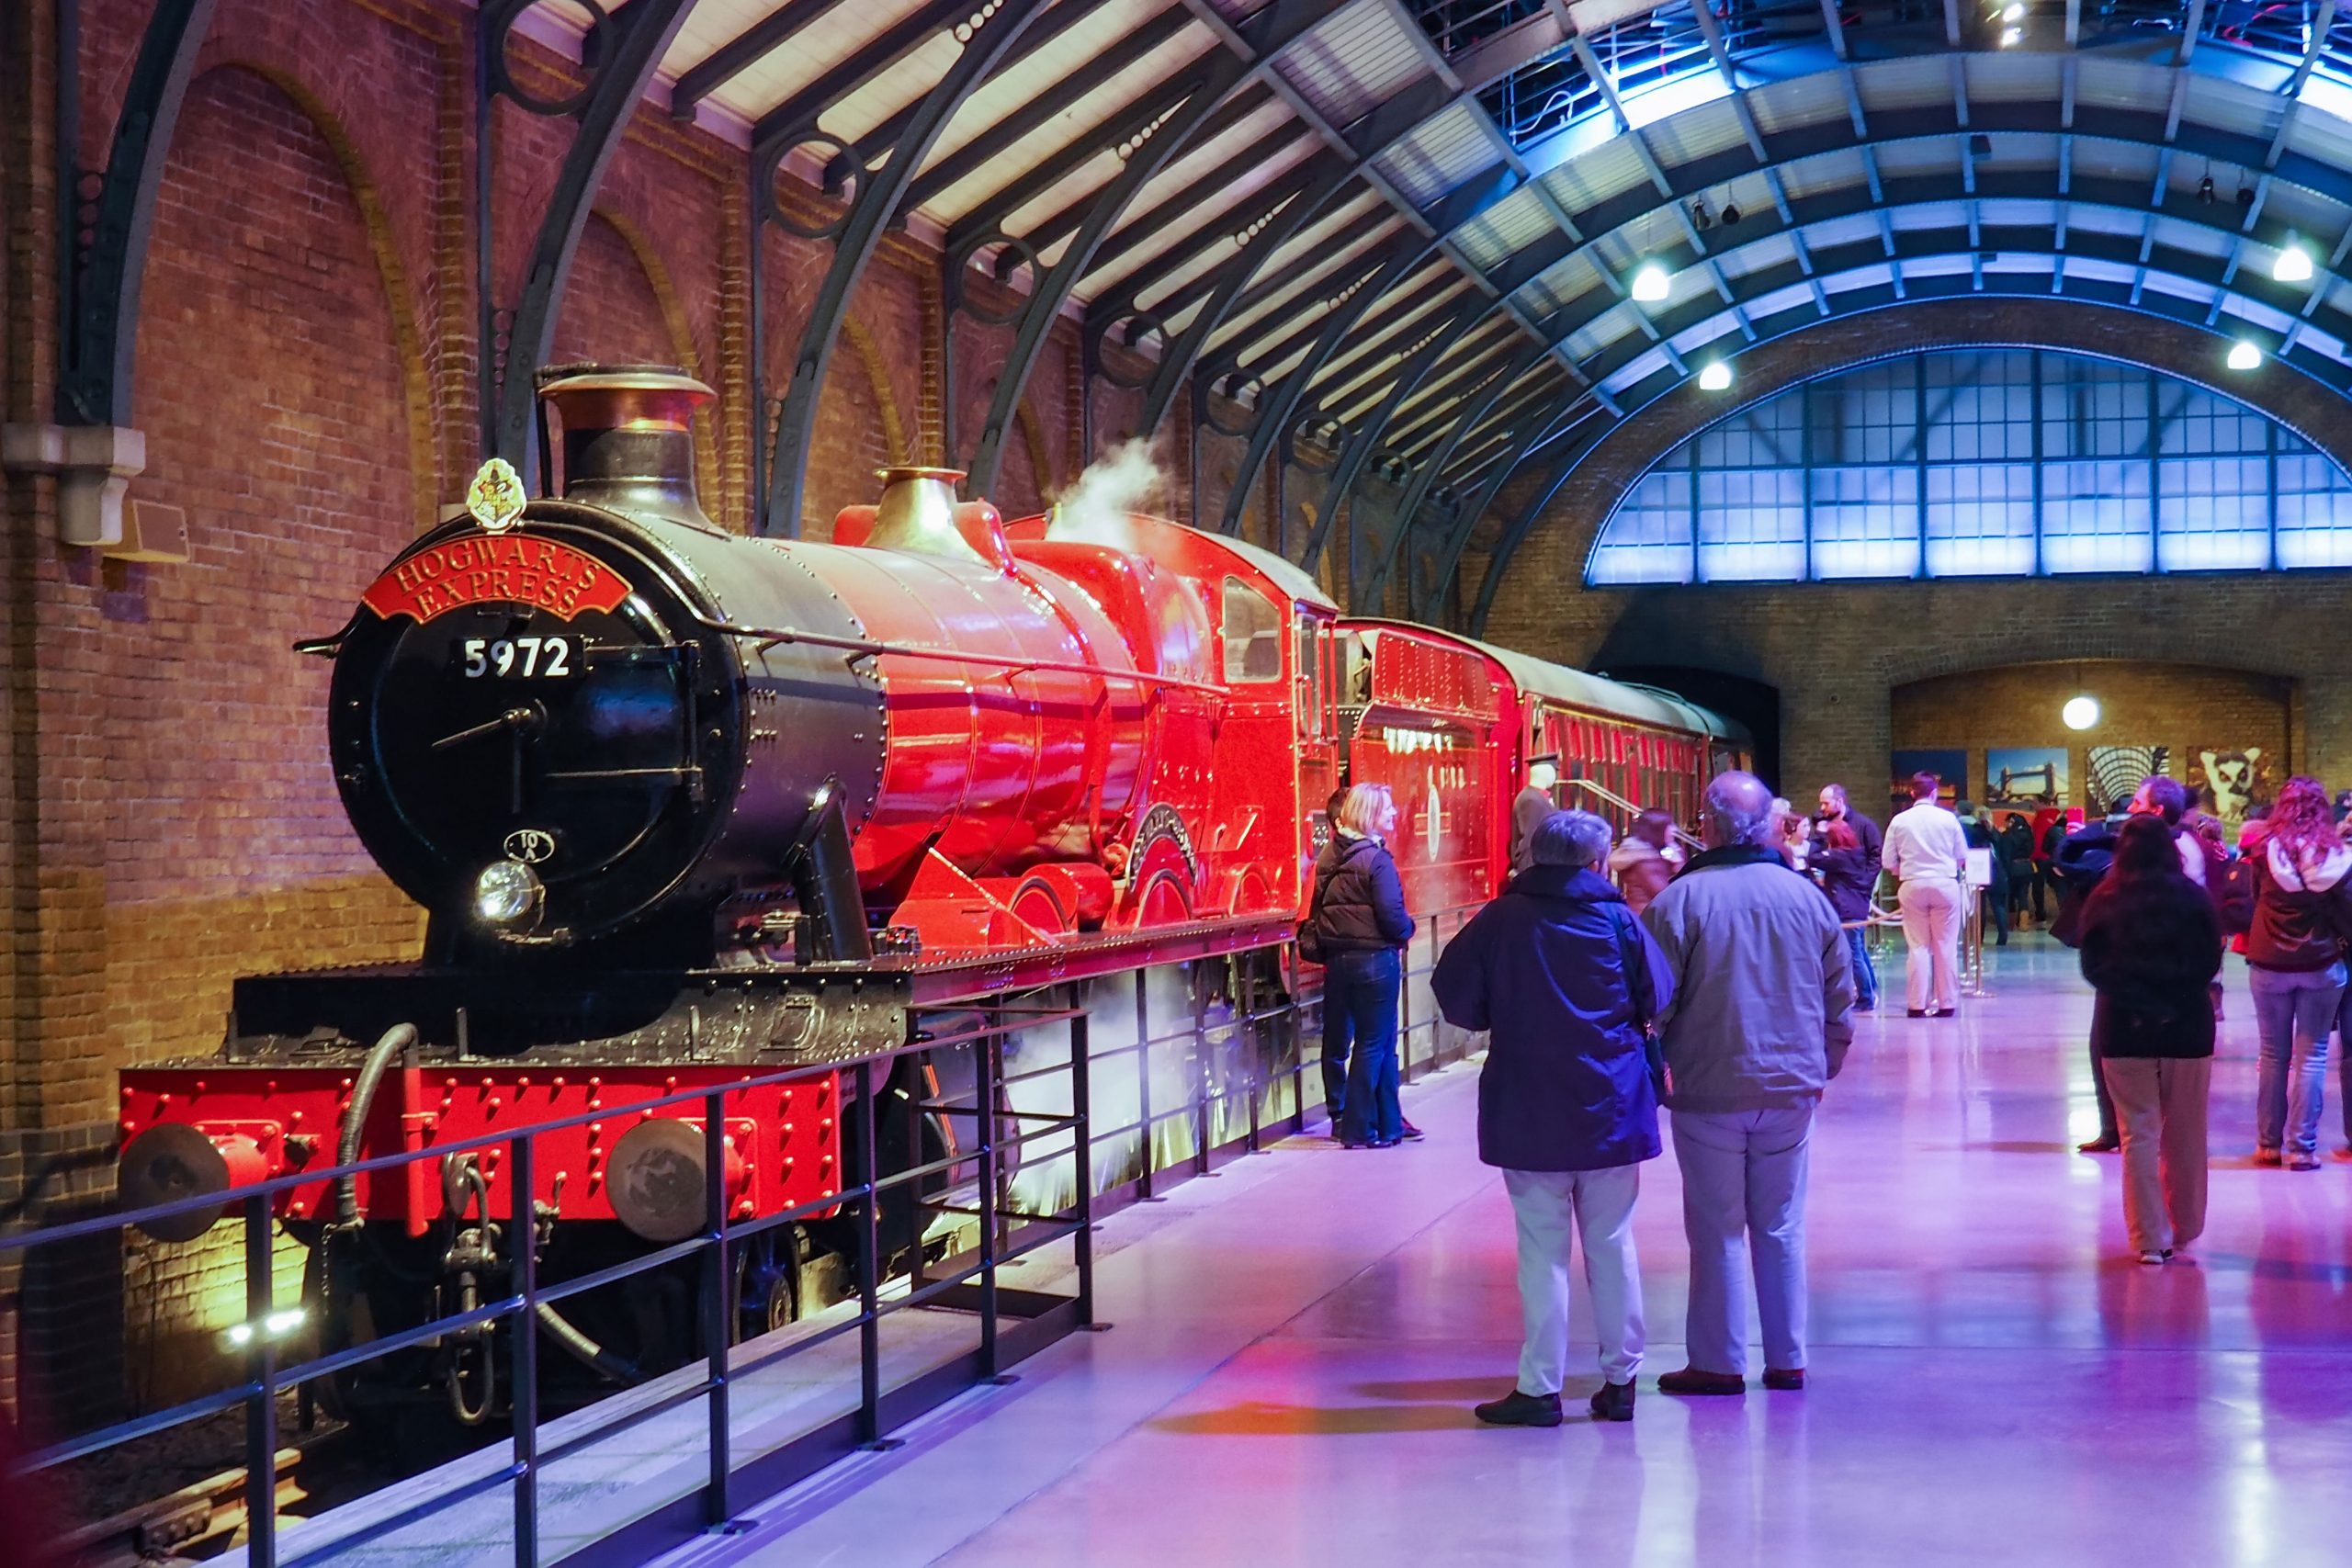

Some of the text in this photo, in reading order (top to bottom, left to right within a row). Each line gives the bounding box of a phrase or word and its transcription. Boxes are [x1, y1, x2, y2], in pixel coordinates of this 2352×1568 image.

[395, 538, 599, 592] HOGWARTS
[415, 570, 577, 616] EXPRESS
[465, 637, 570, 678] 5972
